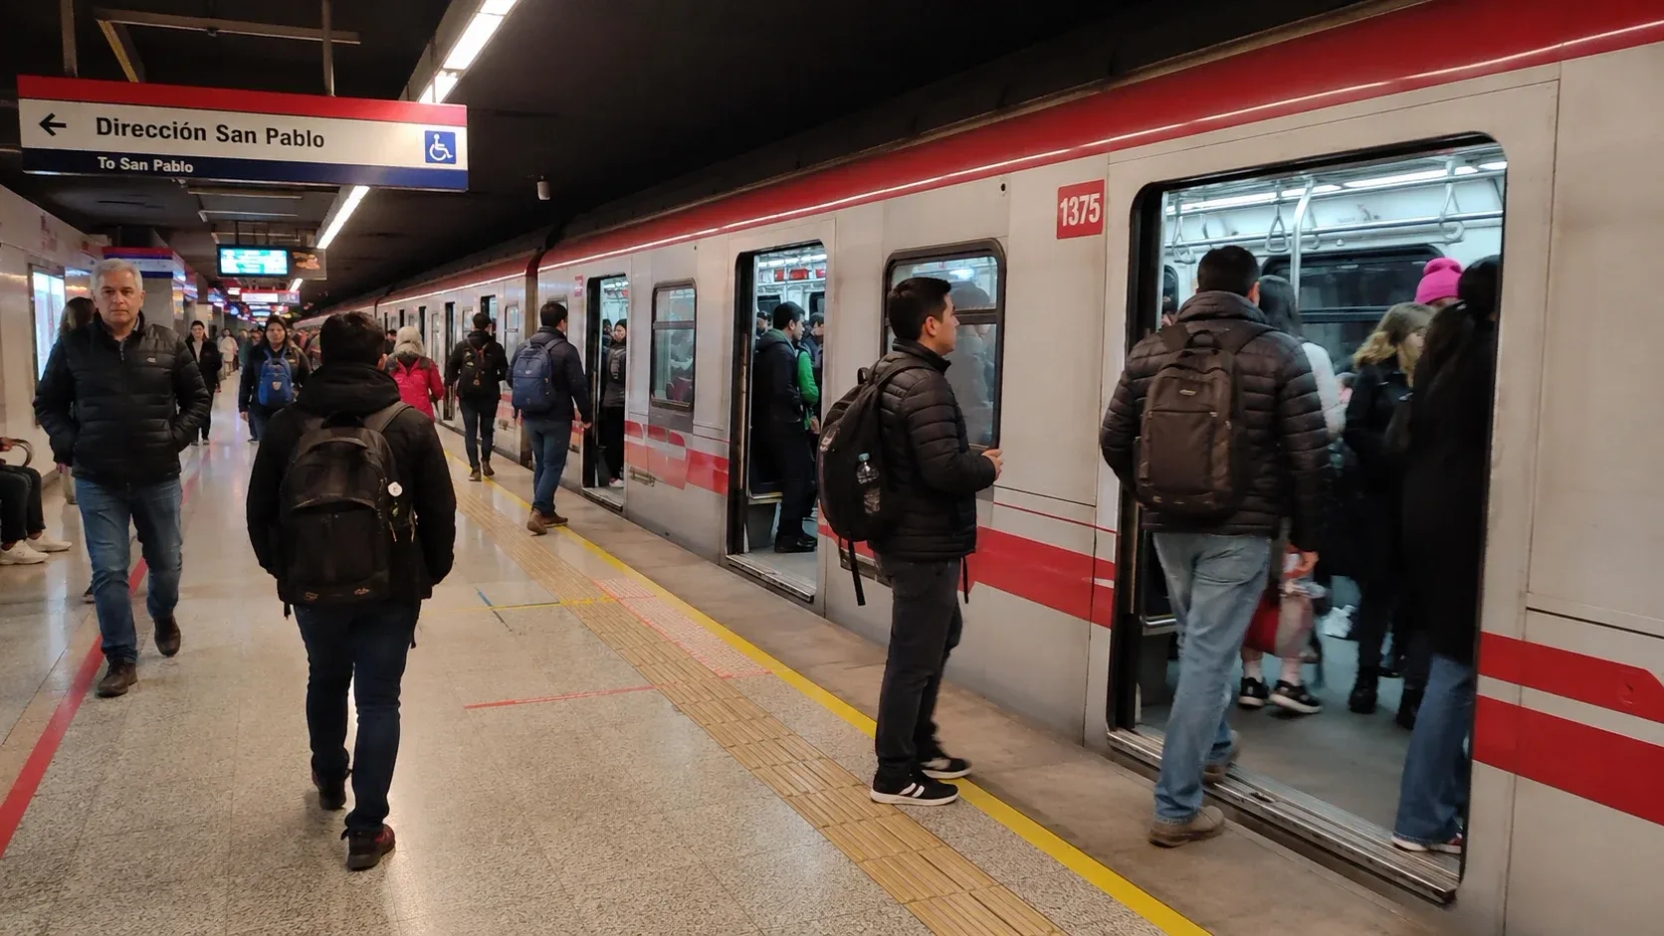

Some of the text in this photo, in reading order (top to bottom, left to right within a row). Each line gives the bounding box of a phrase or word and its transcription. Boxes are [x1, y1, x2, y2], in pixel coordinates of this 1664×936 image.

[96, 117, 325, 148] Dirección San Pablo
[98, 156, 194, 174] To San Pablo
[1060, 193, 1101, 227] 1375
